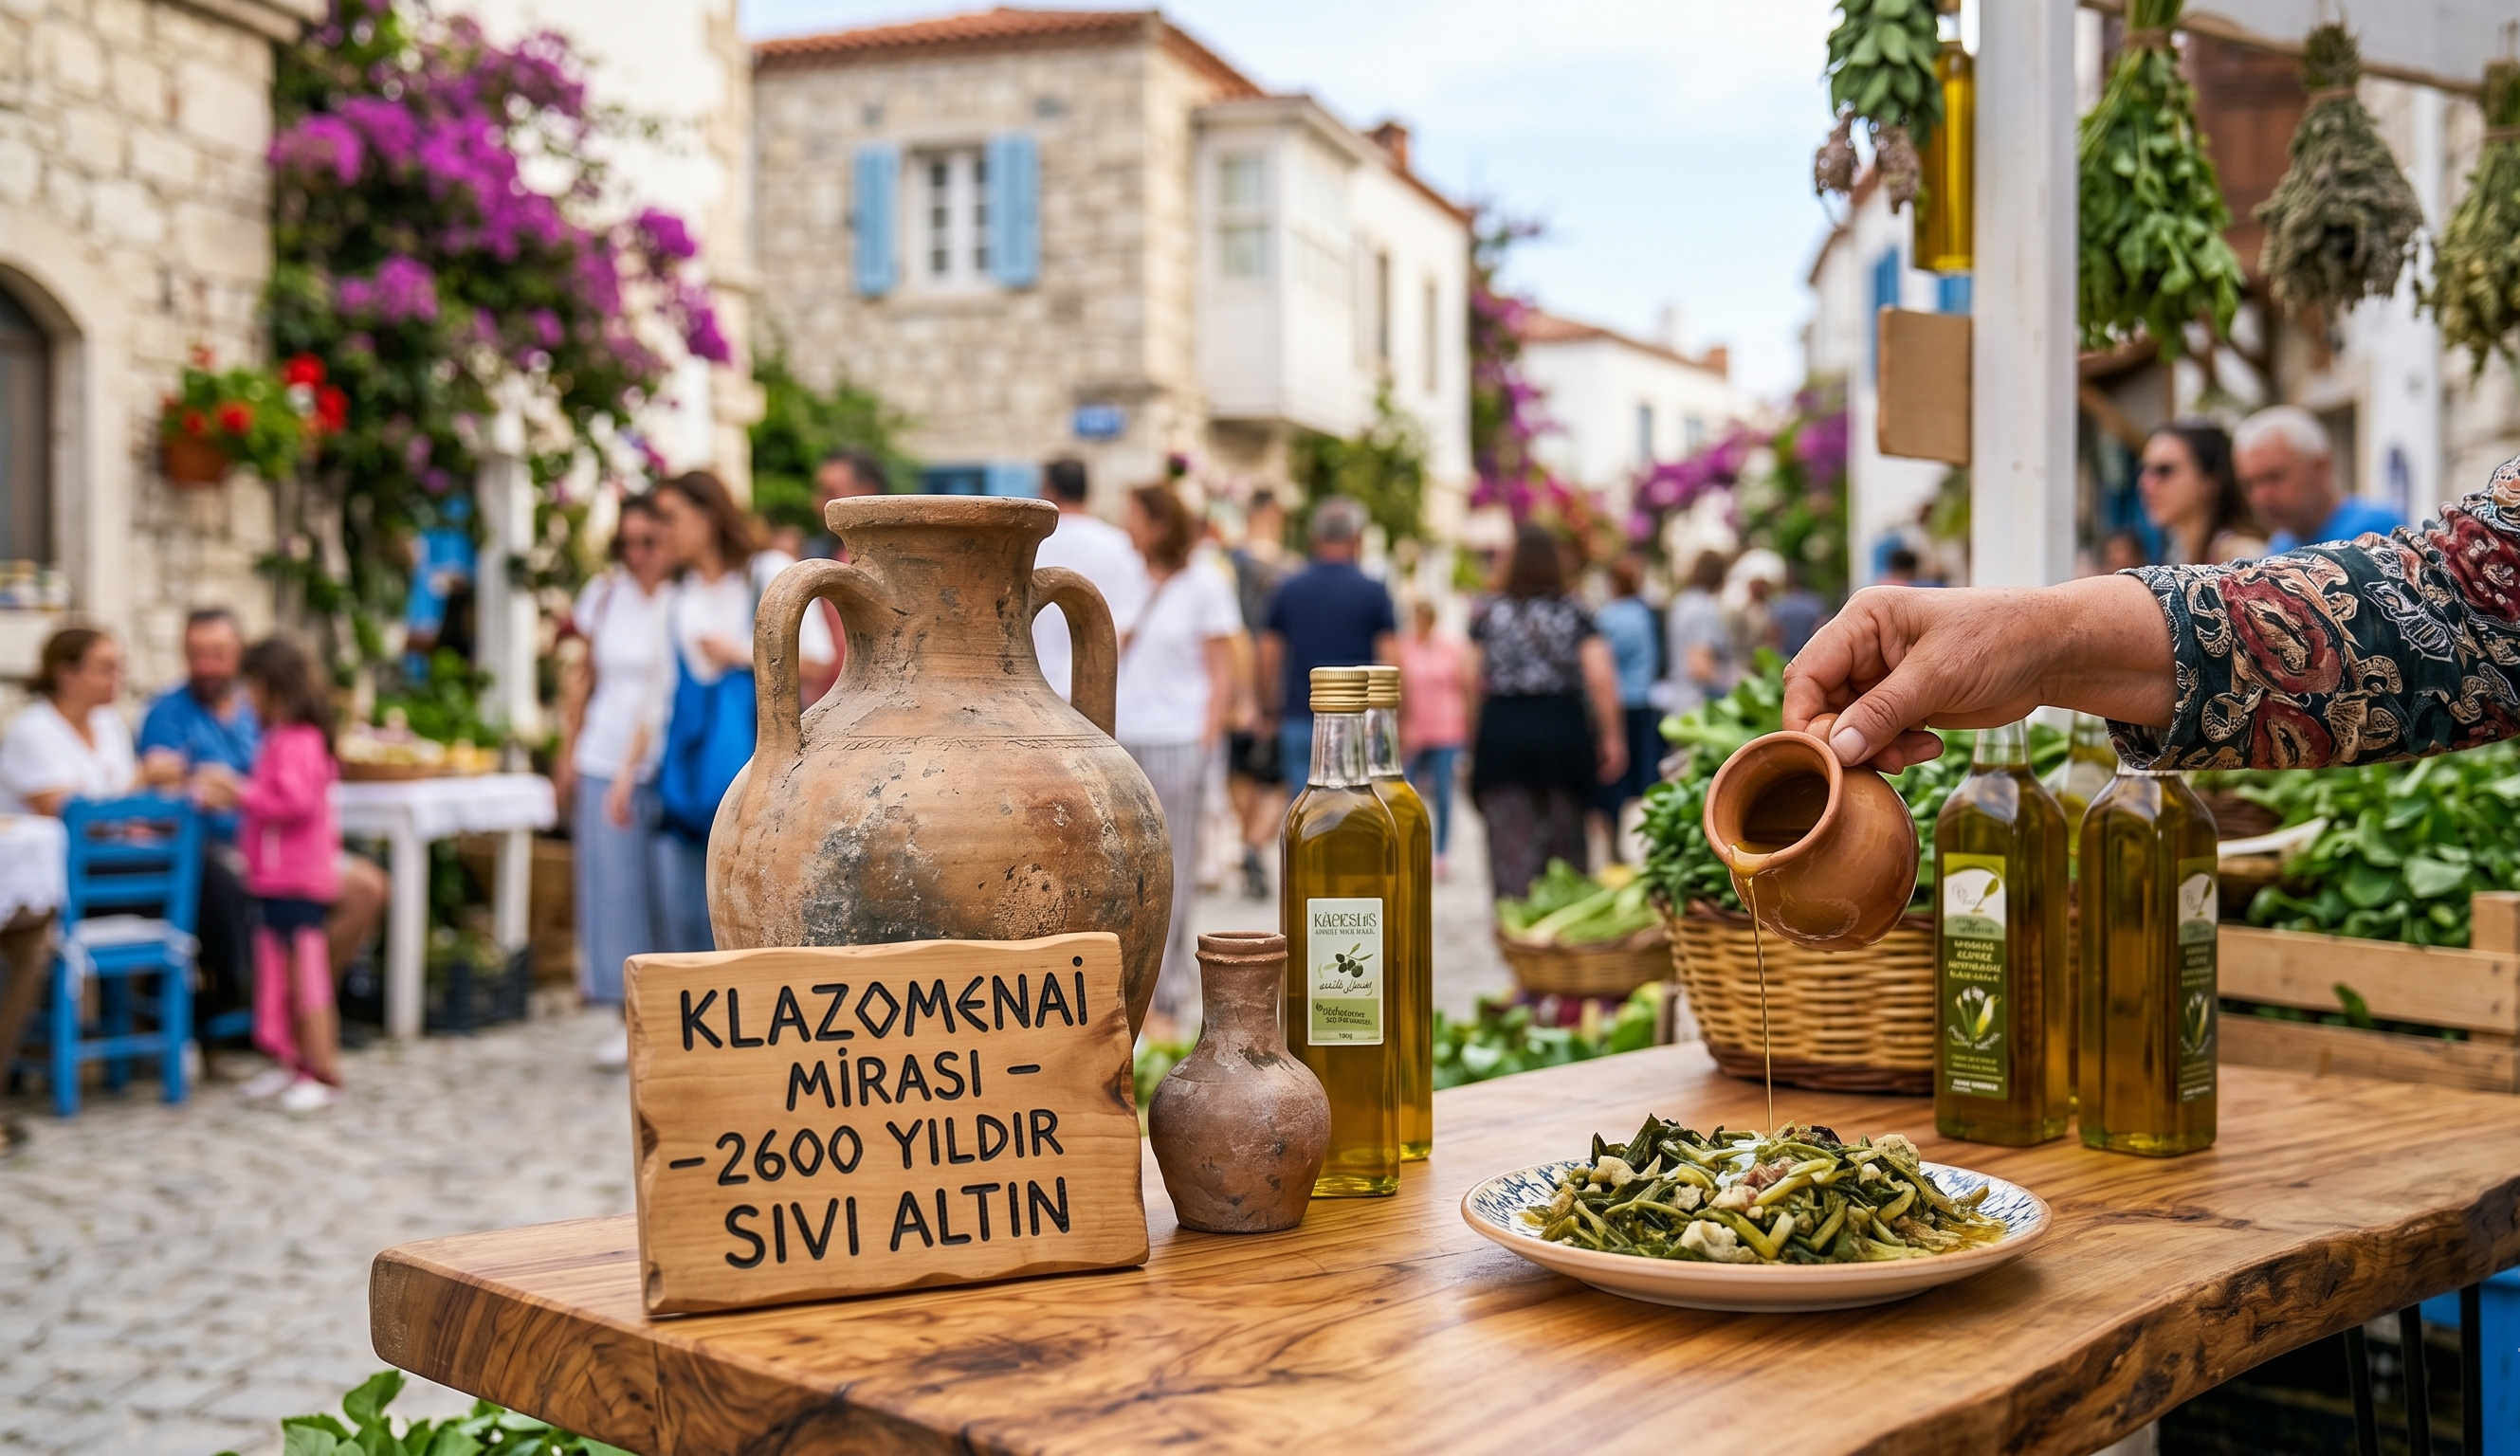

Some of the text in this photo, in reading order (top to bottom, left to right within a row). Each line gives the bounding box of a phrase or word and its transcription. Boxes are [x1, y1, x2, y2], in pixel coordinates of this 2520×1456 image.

[786, 1046, 982, 1112] MİRASI
[886, 1108, 1064, 1170] YILDIR
[724, 1175, 1070, 1269] SIVI ALTIN
